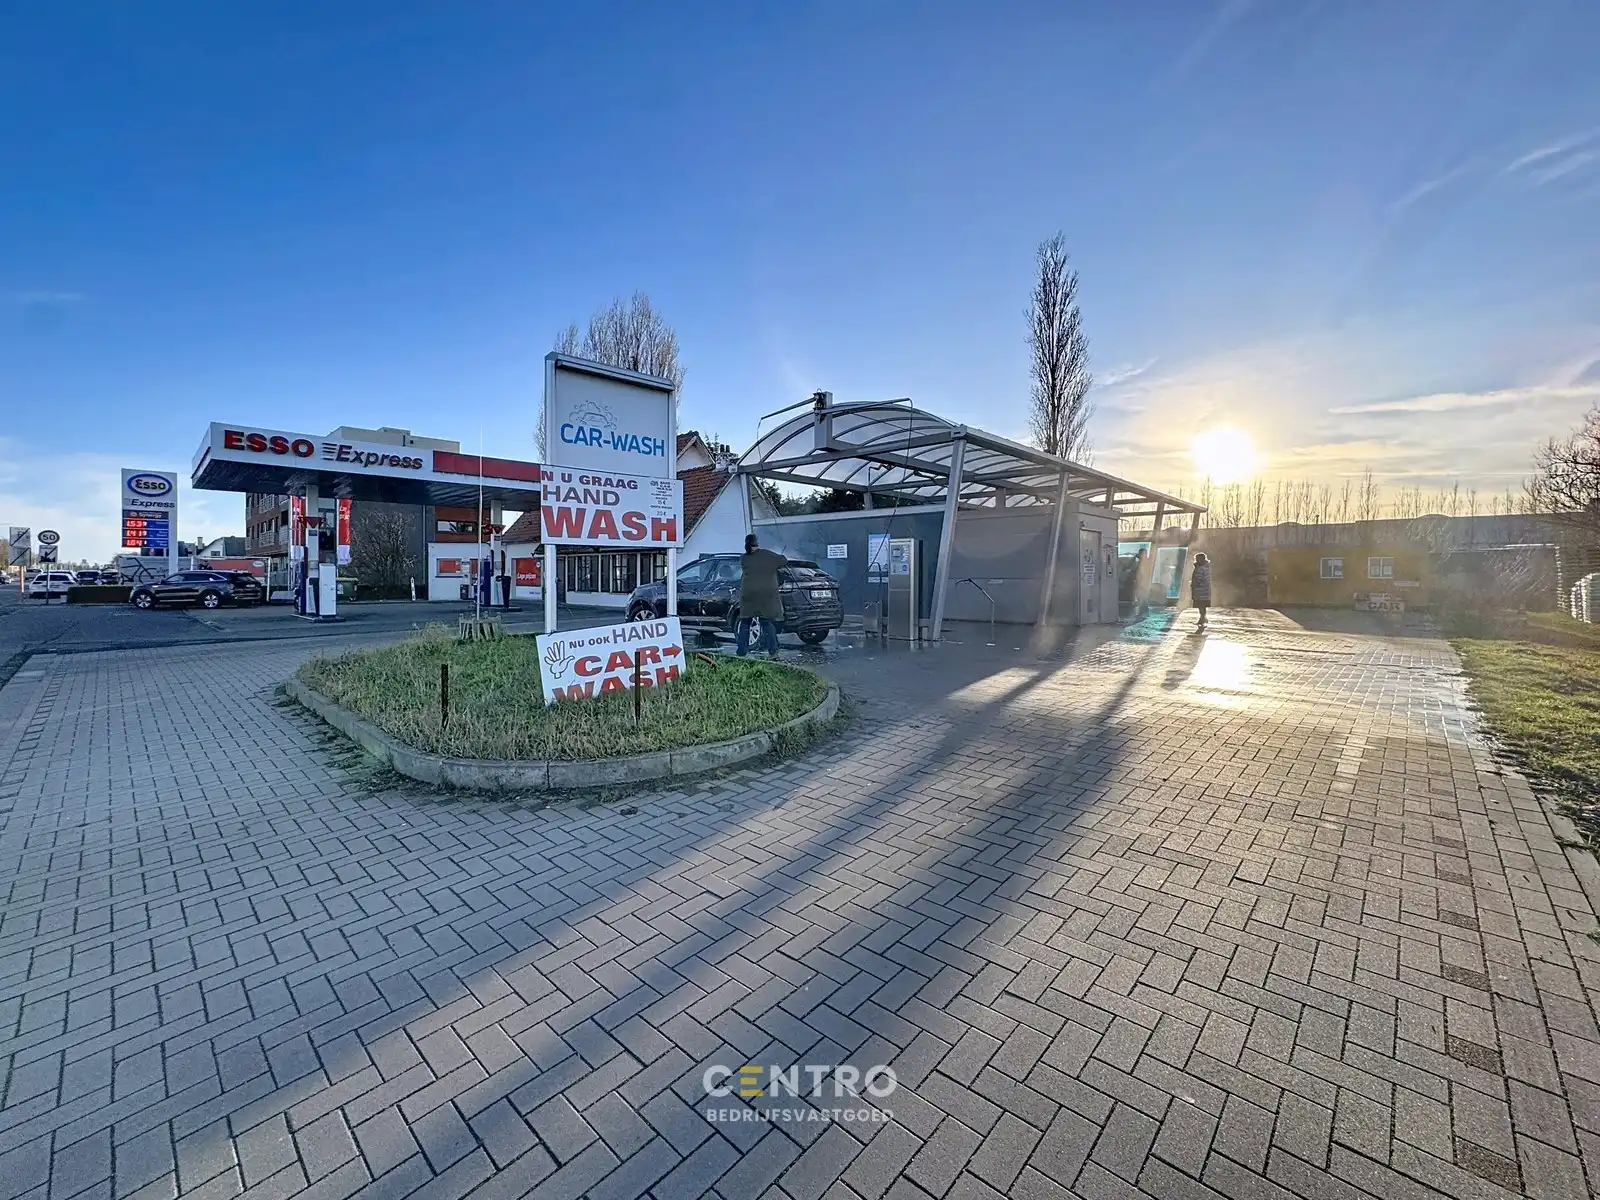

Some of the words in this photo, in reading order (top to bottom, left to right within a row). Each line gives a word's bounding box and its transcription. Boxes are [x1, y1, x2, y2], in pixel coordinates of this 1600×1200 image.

[224, 429, 315, 458] ESSO
[334, 444, 424, 470] Express
[560, 423, 665, 457] CAR-WASH
[542, 484, 621, 507] HAND
[578, 474, 638, 490] GRAAG
[131, 498, 176, 509] Express
[541, 505, 677, 542] WASH
[569, 639, 585, 650] NU
[588, 635, 611, 646] OOK
[612, 622, 668, 645] HAND
[573, 645, 662, 678] CAR
